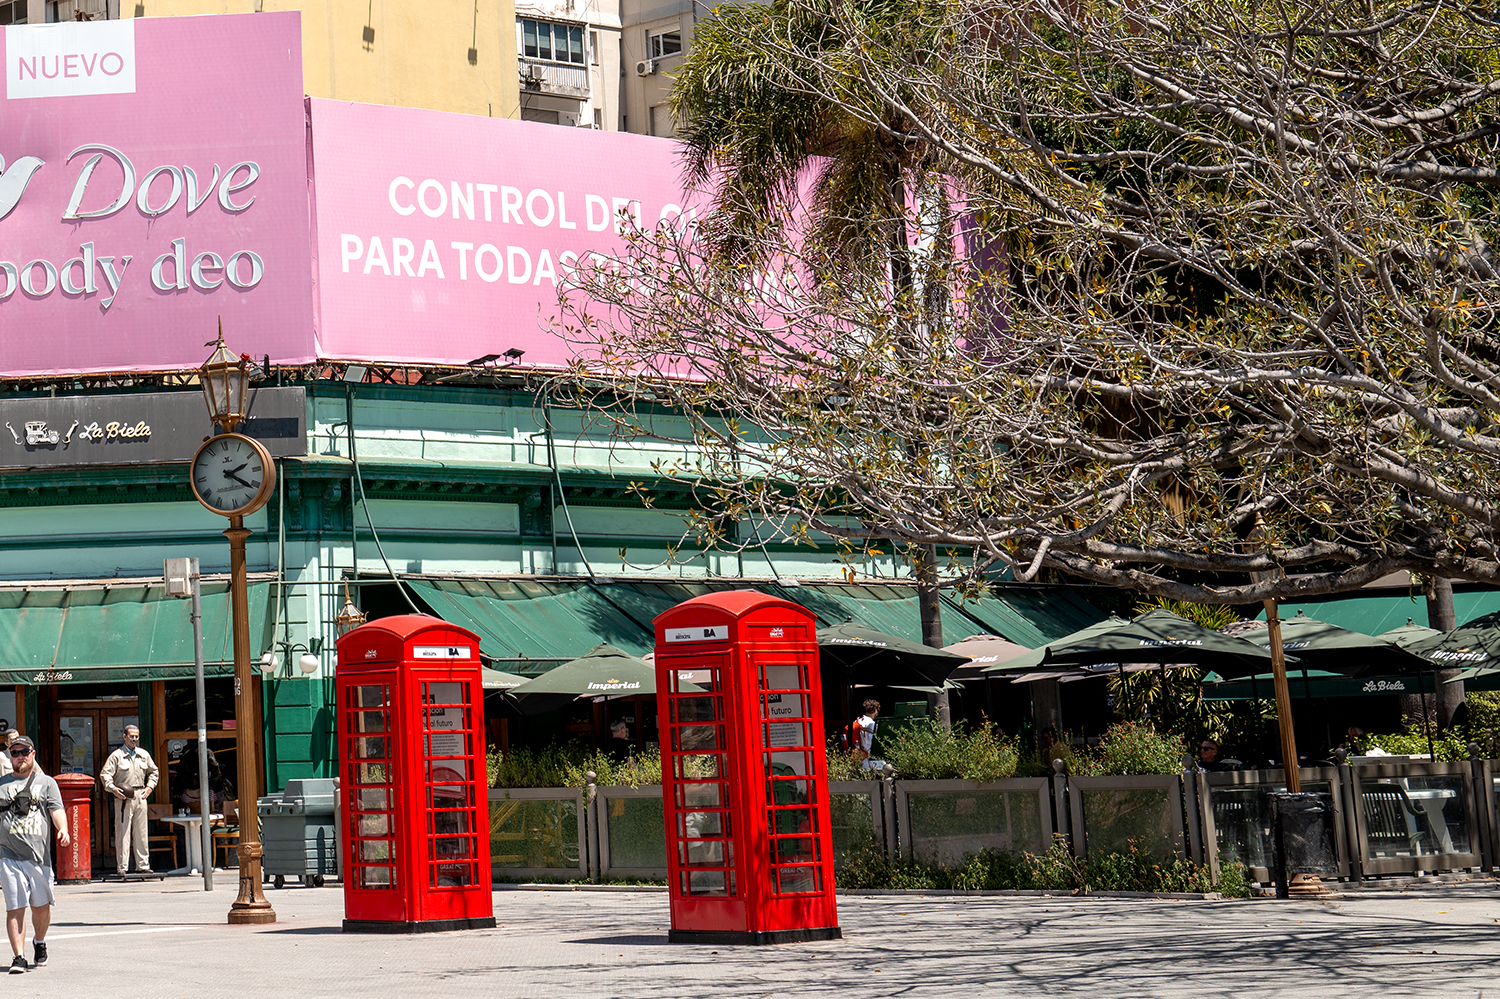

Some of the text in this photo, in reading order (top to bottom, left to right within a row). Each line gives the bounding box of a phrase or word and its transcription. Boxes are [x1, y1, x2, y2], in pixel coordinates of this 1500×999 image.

[18, 51, 124, 81] NUEVO
[61, 143, 261, 221] Dove
[388, 176, 577, 231] CONTROL
[150, 237, 265, 292] deo
[340, 233, 581, 291] PARA TODAS
[79, 420, 152, 441] La Biela
[704, 628, 716, 638] BA
[448, 647, 460, 656] BA
[33, 670, 73, 683] La Biela
[587, 681, 641, 691] Imperial
[1362, 680, 1405, 693] La Biela
[771, 706, 792, 716] futuro
[436, 719, 454, 728] futuro
